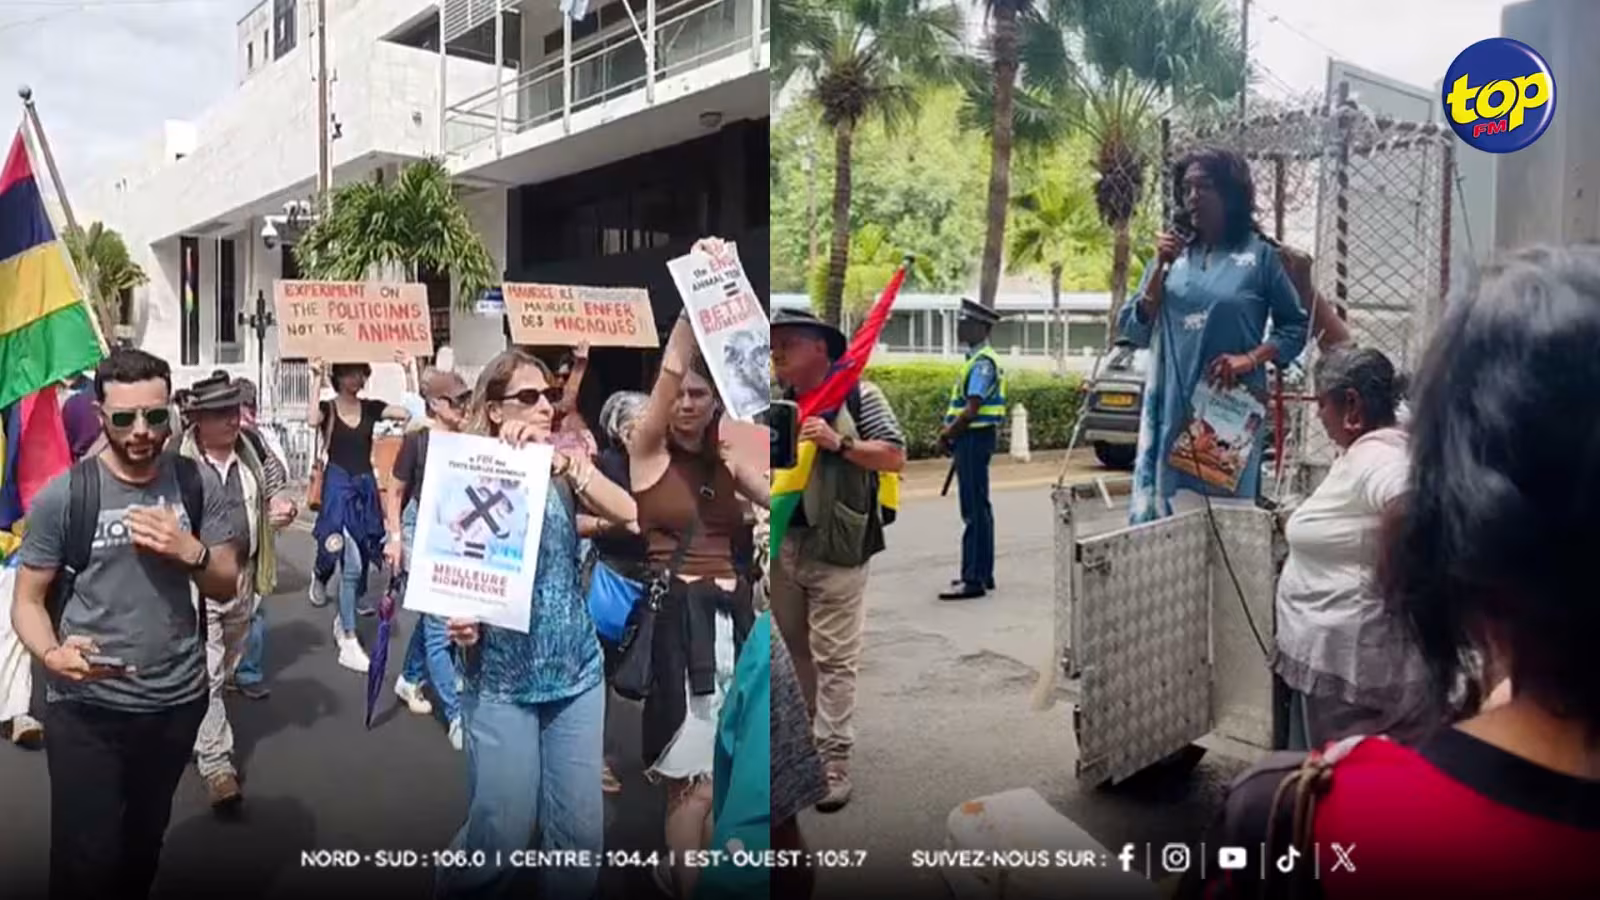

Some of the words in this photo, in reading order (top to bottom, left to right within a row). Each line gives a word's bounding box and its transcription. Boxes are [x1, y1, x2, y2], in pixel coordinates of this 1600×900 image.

[284, 283, 366, 299] EXPERIMENT
[380, 286, 400, 299] ON
[291, 302, 319, 317] THE
[328, 302, 422, 319] POLITICIANS
[524, 301, 576, 314] MAURICE
[584, 301, 635, 318] ENFER
[521, 314, 544, 328] DES
[287, 322, 315, 337] NOT
[324, 322, 348, 336] THE
[357, 323, 429, 343] ANIMALS
[433, 562, 509, 586] MEILLEURE
